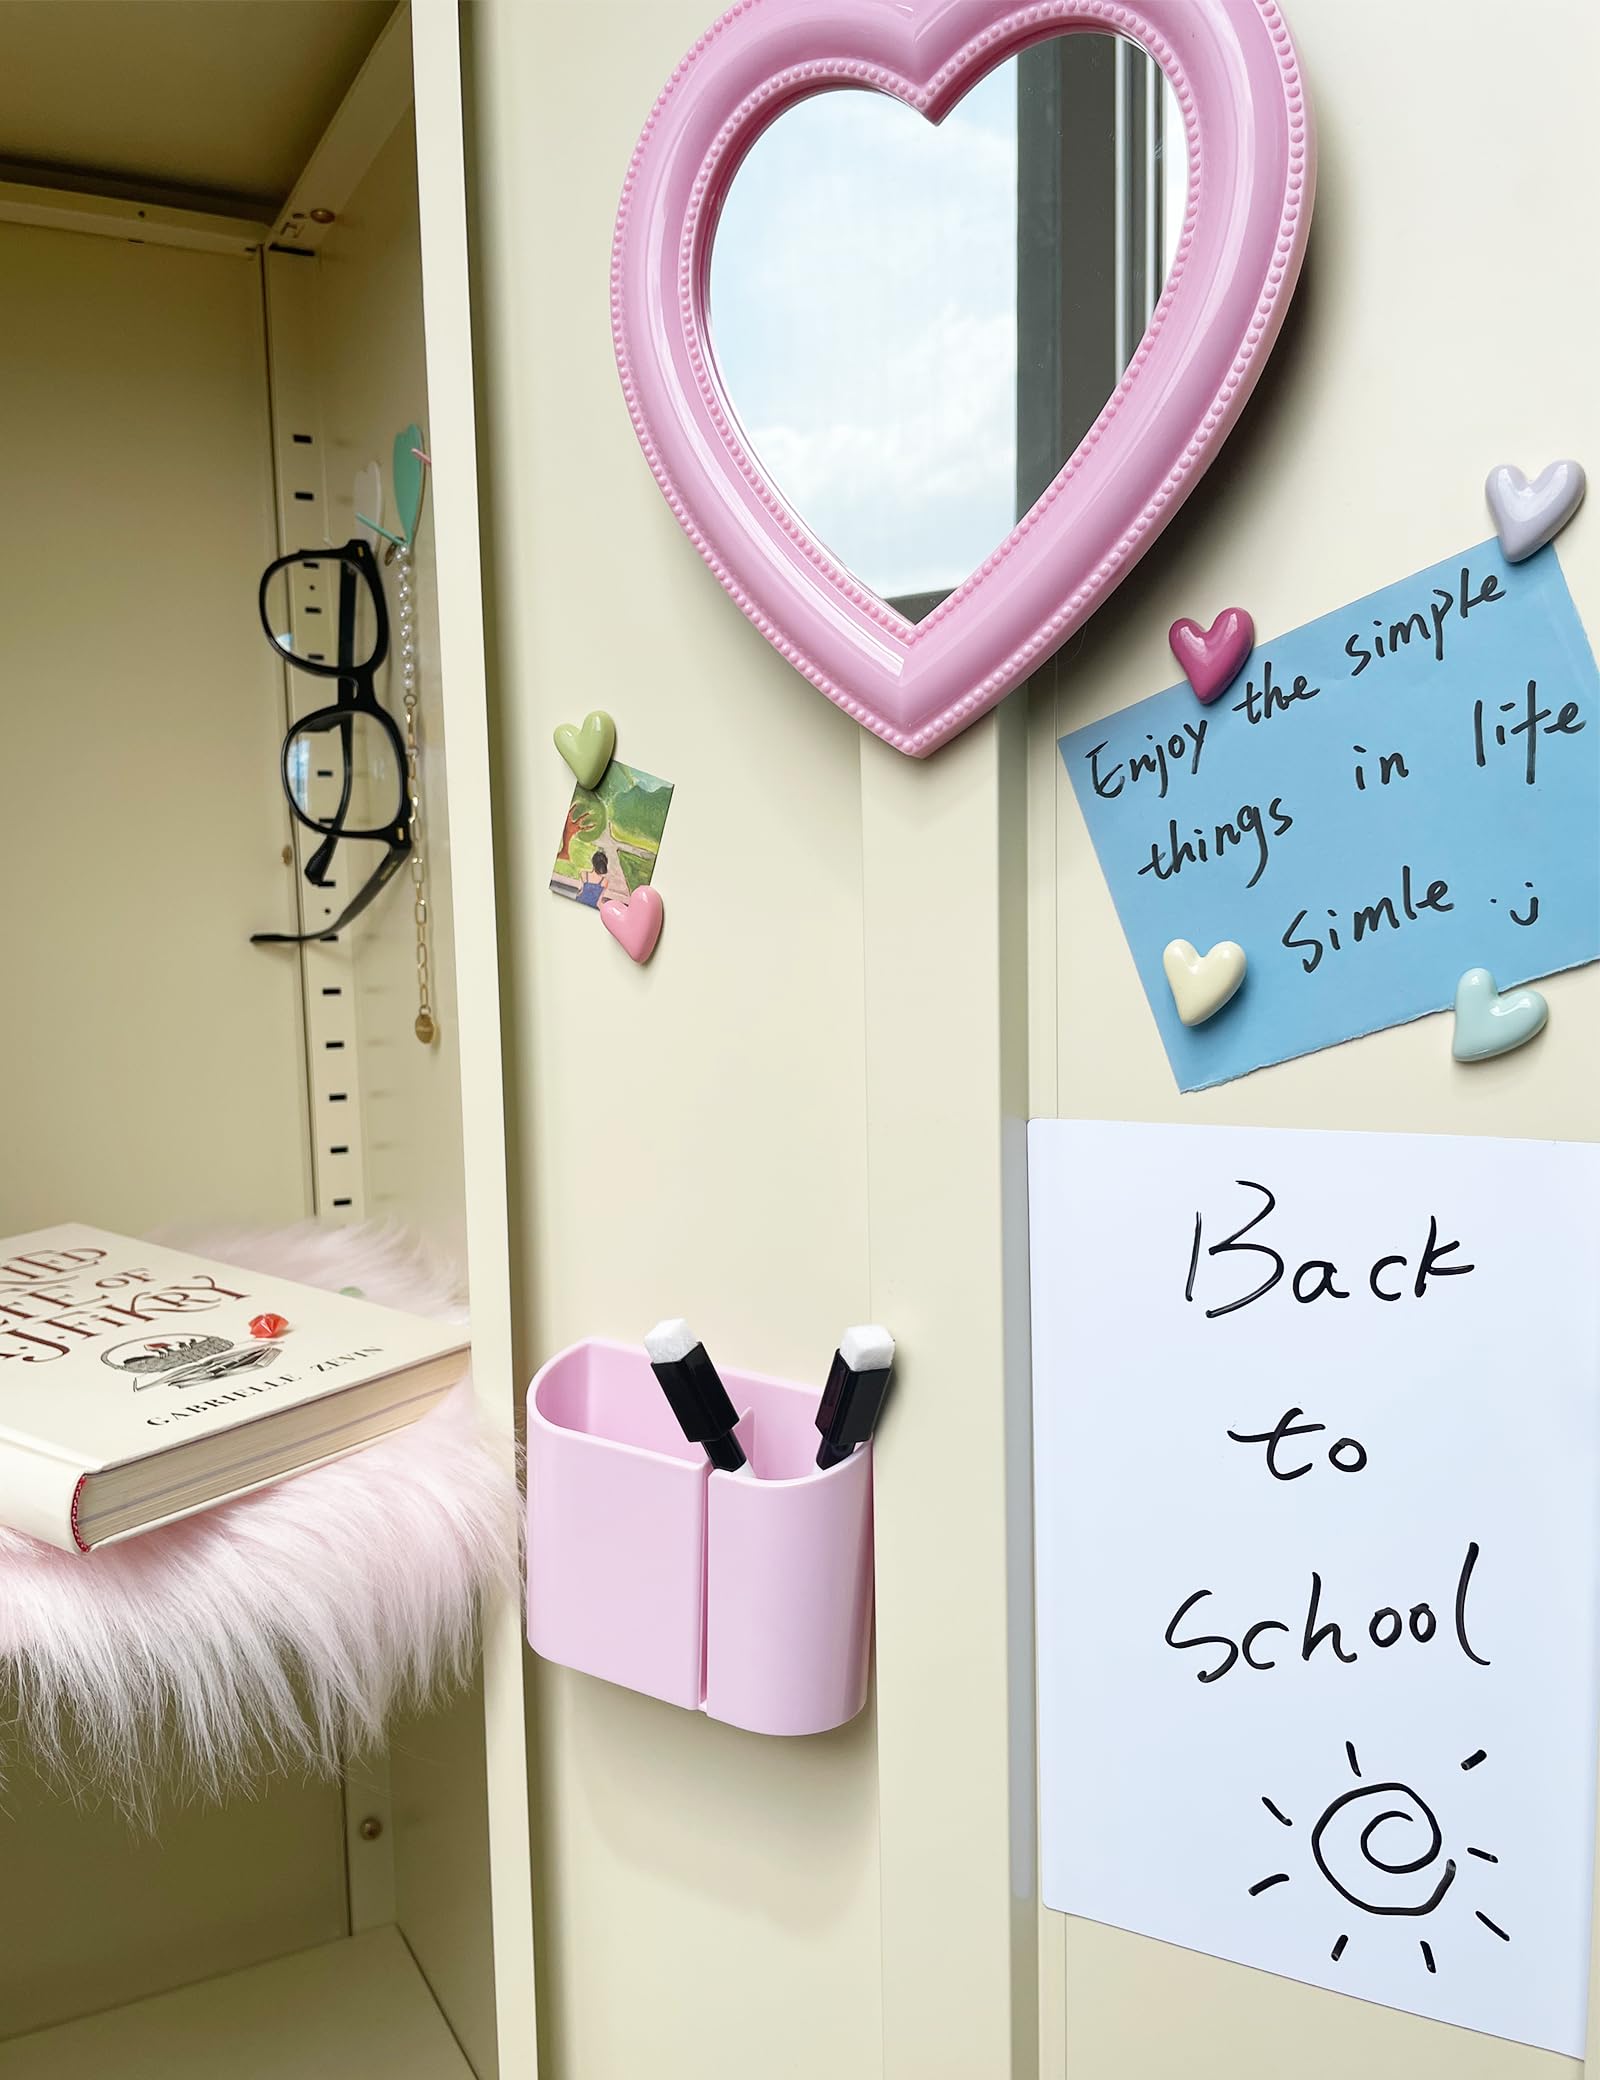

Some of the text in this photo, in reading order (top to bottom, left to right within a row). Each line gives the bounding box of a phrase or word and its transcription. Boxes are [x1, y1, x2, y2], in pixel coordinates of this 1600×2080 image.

[1085, 567, 1507, 798] Enjoy the simple
[1137, 680, 1586, 889] things in life
[95, 1267, 155, 1289] OF
[1185, 1180, 1475, 1319] Back
[146, 1345, 385, 1427] GABRIELLE ZEVIN
[1226, 1407, 1368, 1481] to
[1164, 1541, 1491, 1684] School
